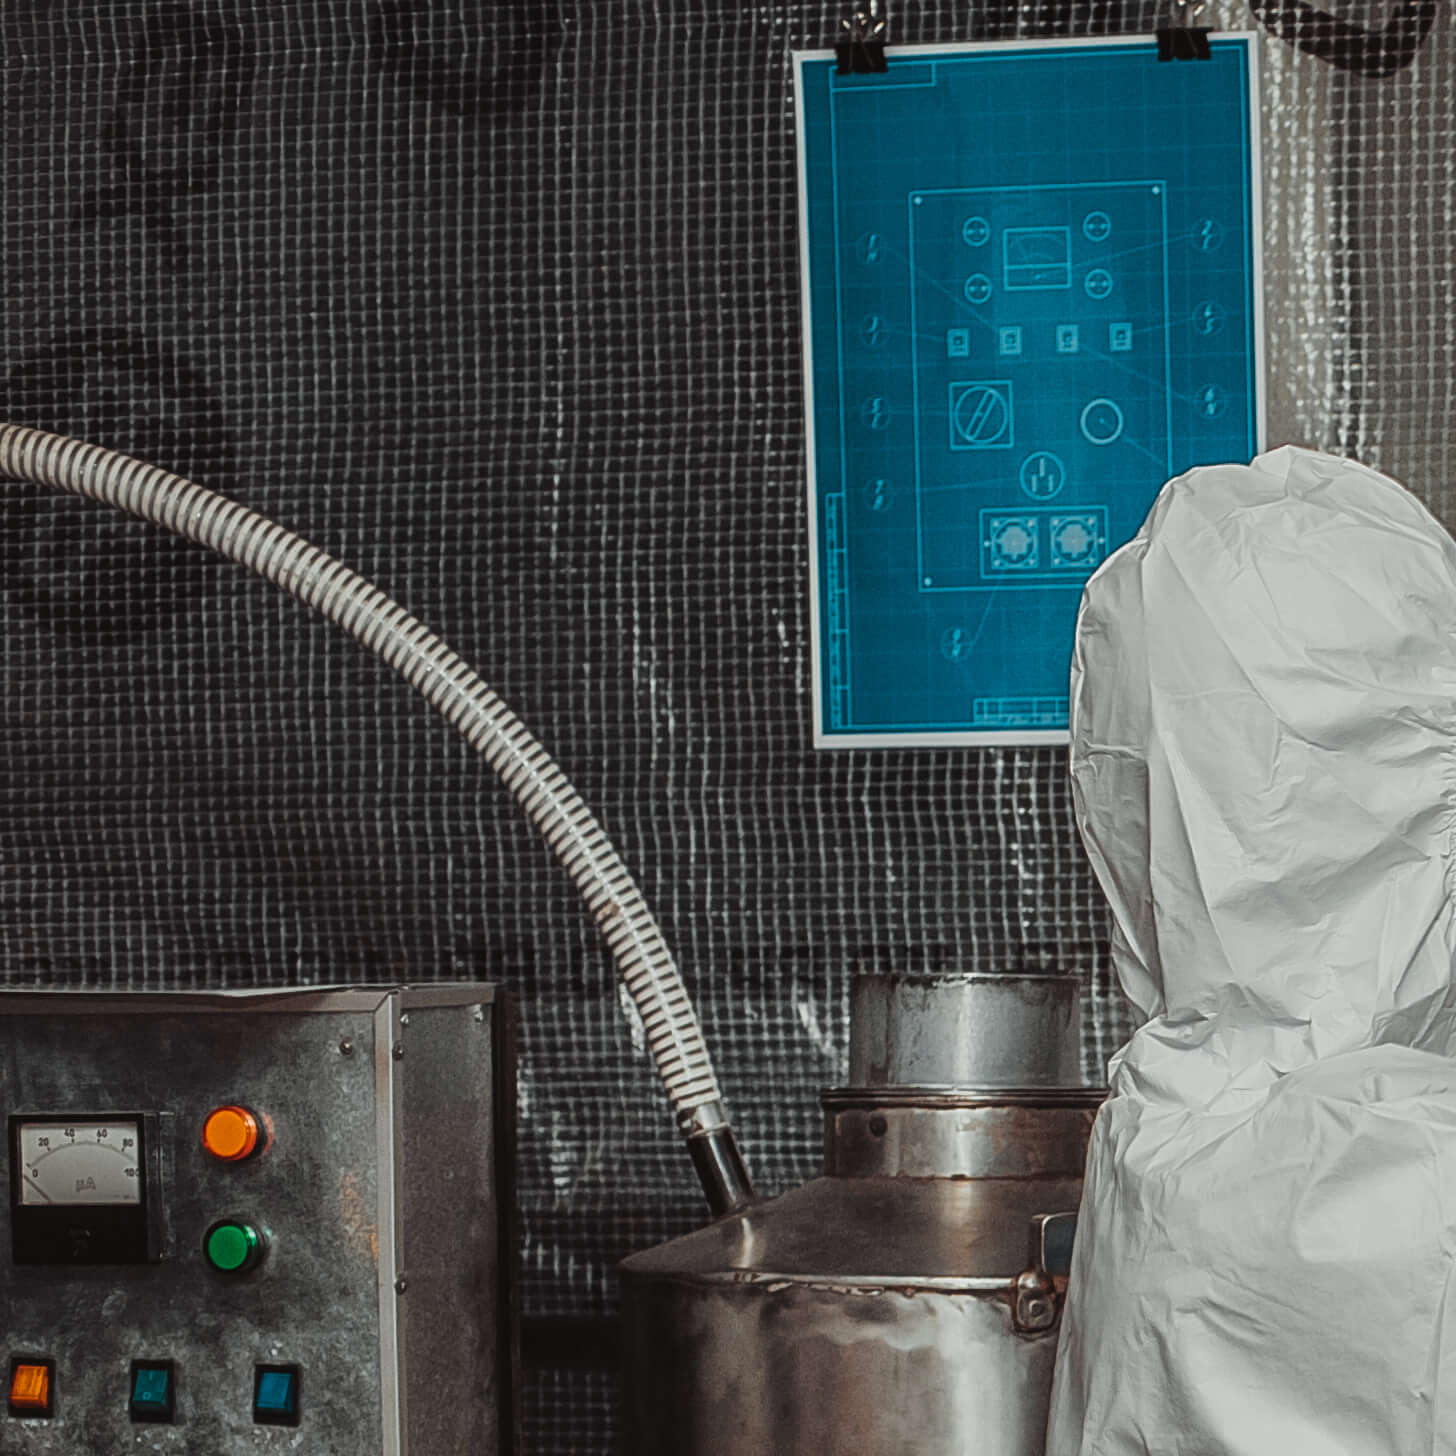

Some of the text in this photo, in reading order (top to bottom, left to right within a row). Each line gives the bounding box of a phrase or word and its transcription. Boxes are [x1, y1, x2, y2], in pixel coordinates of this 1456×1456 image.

[38, 1137, 49, 1147] 20
[64, 1128, 75, 1138] 40
[96, 1128, 108, 1138] 60
[122, 1138, 134, 1148] 80
